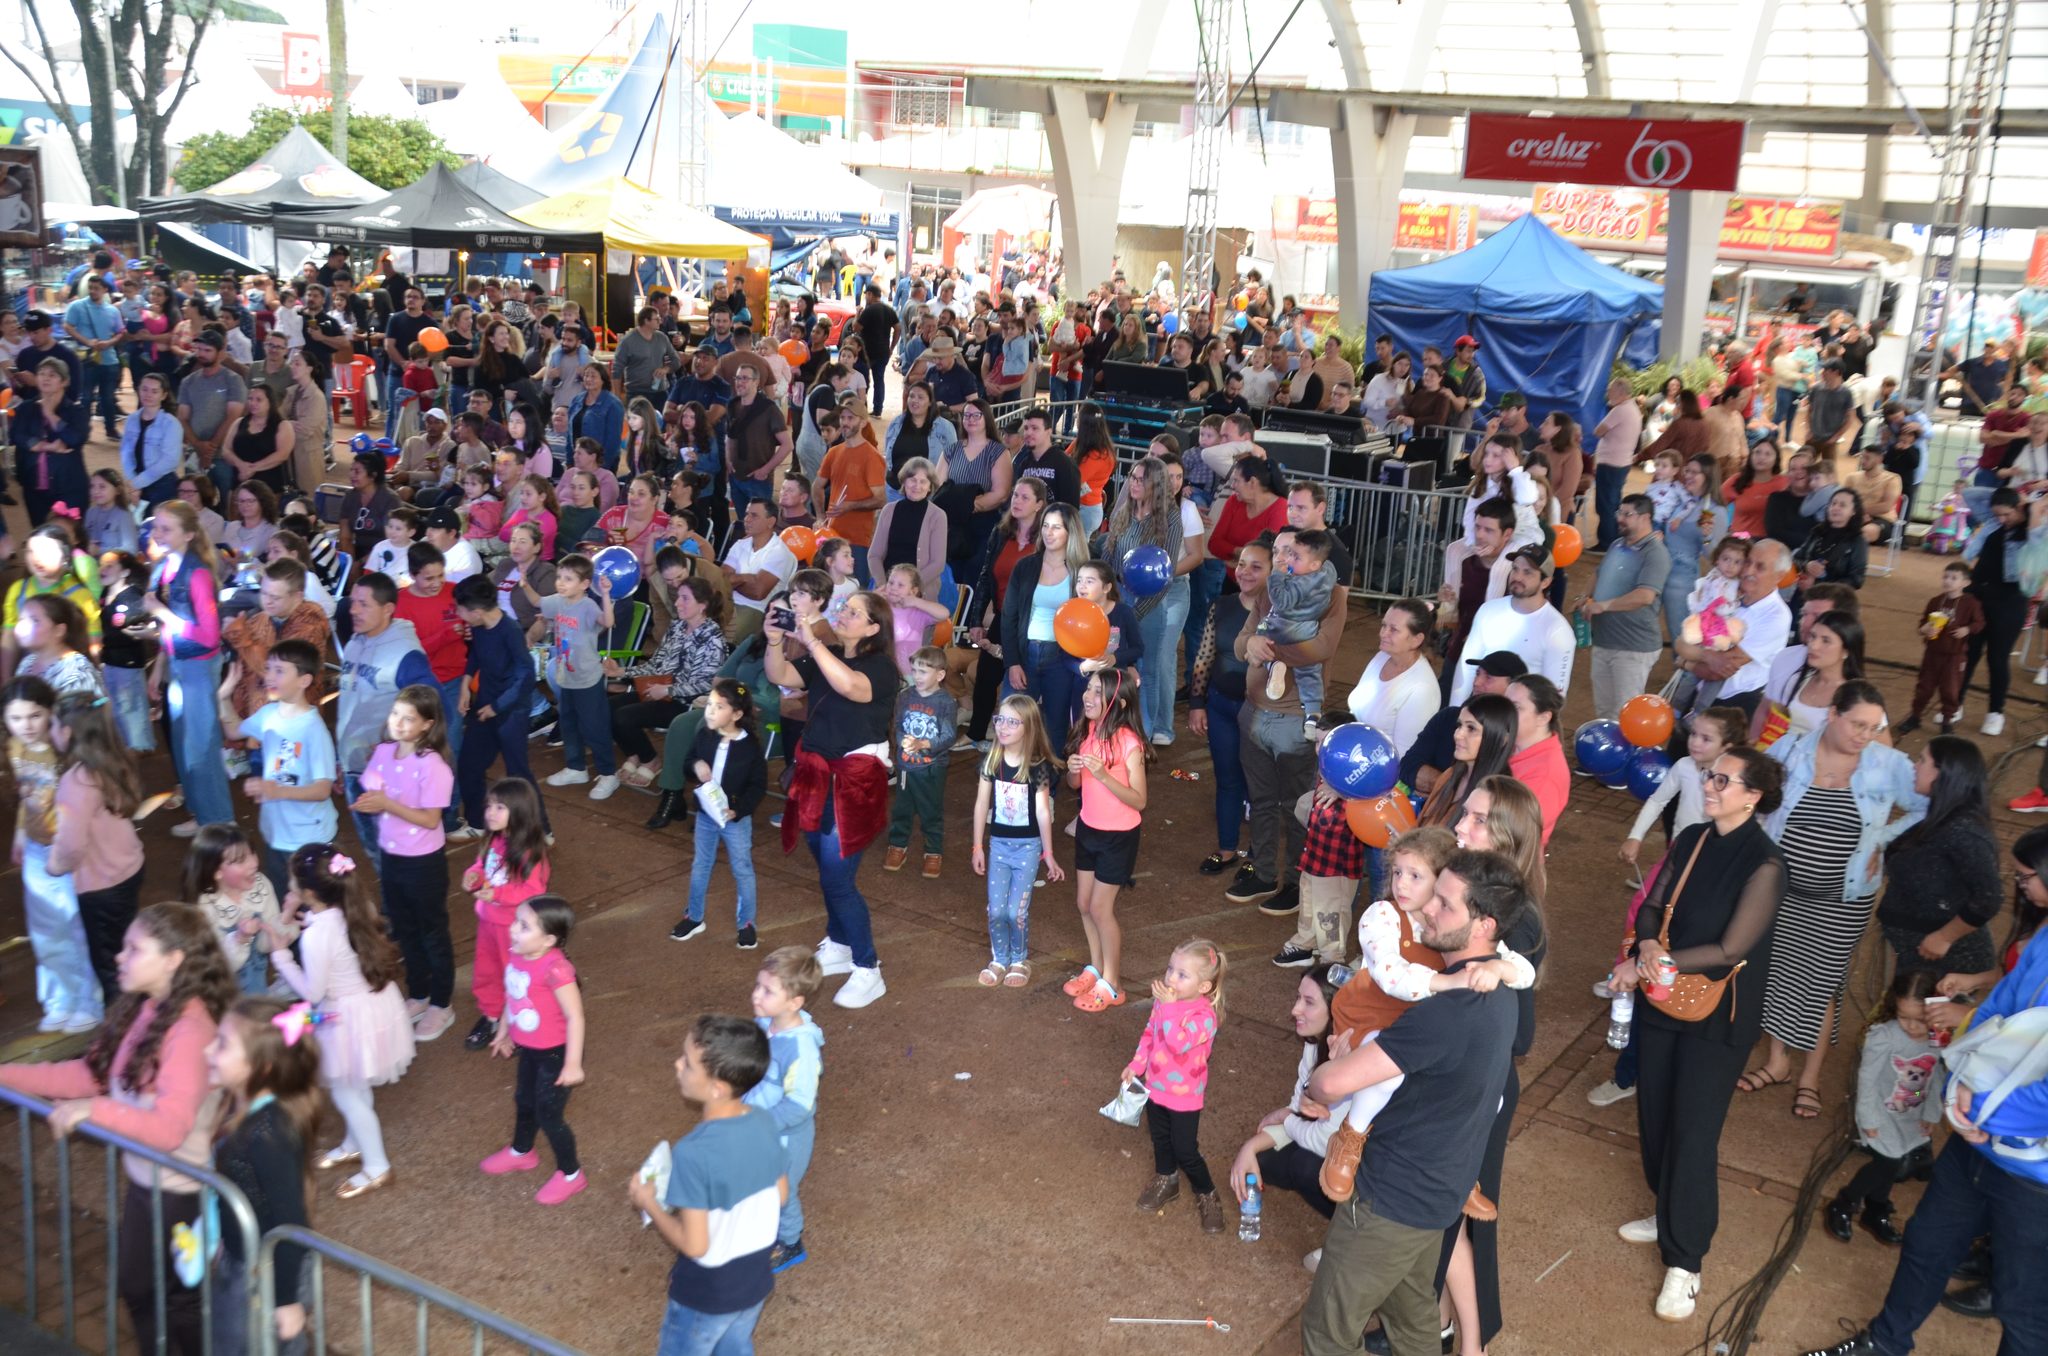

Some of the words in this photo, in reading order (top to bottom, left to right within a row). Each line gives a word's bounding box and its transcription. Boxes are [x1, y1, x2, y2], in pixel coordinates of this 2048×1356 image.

[1507, 132, 1594, 162] creluz
[1625, 122, 1693, 186] 60
[1541, 189, 1616, 213] SUPER
[1743, 205, 1809, 231] XIS
[491, 235, 530, 245] HOFFNUNG
